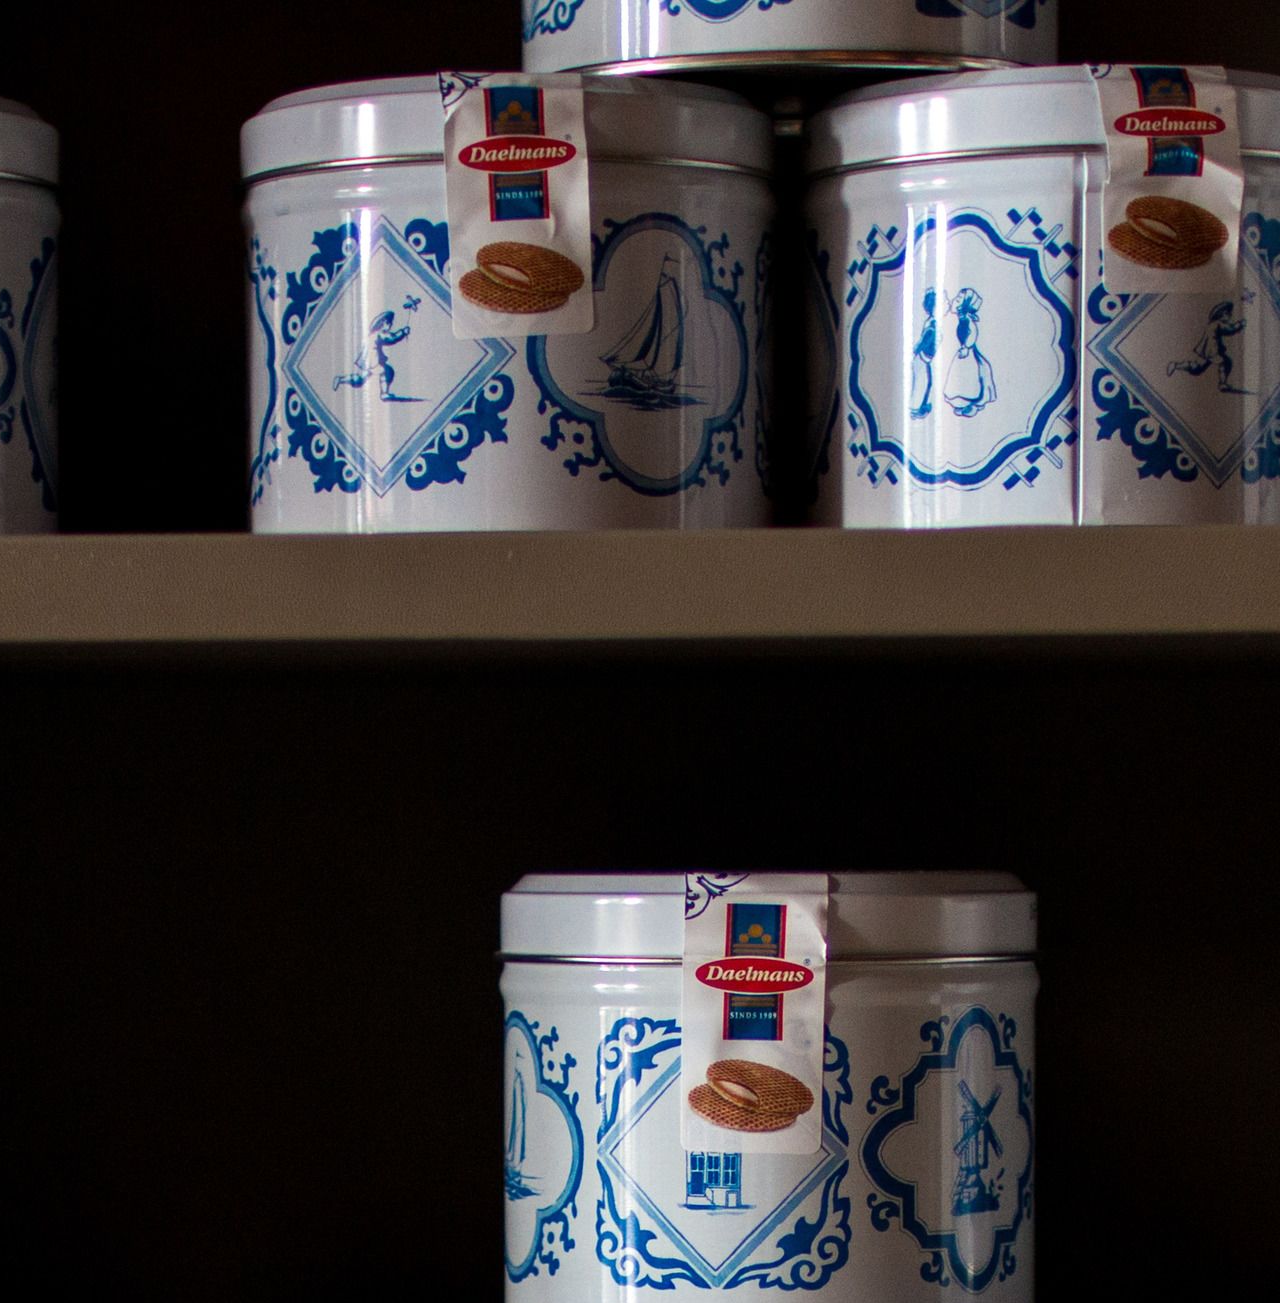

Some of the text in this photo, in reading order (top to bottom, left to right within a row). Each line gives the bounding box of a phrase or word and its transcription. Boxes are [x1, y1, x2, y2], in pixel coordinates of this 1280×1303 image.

[1125, 117, 1217, 132] Daelmans
[470, 145, 566, 162] Daelmans
[706, 966, 804, 981] Daelmans
[729, 1011, 756, 1020] SINDS
